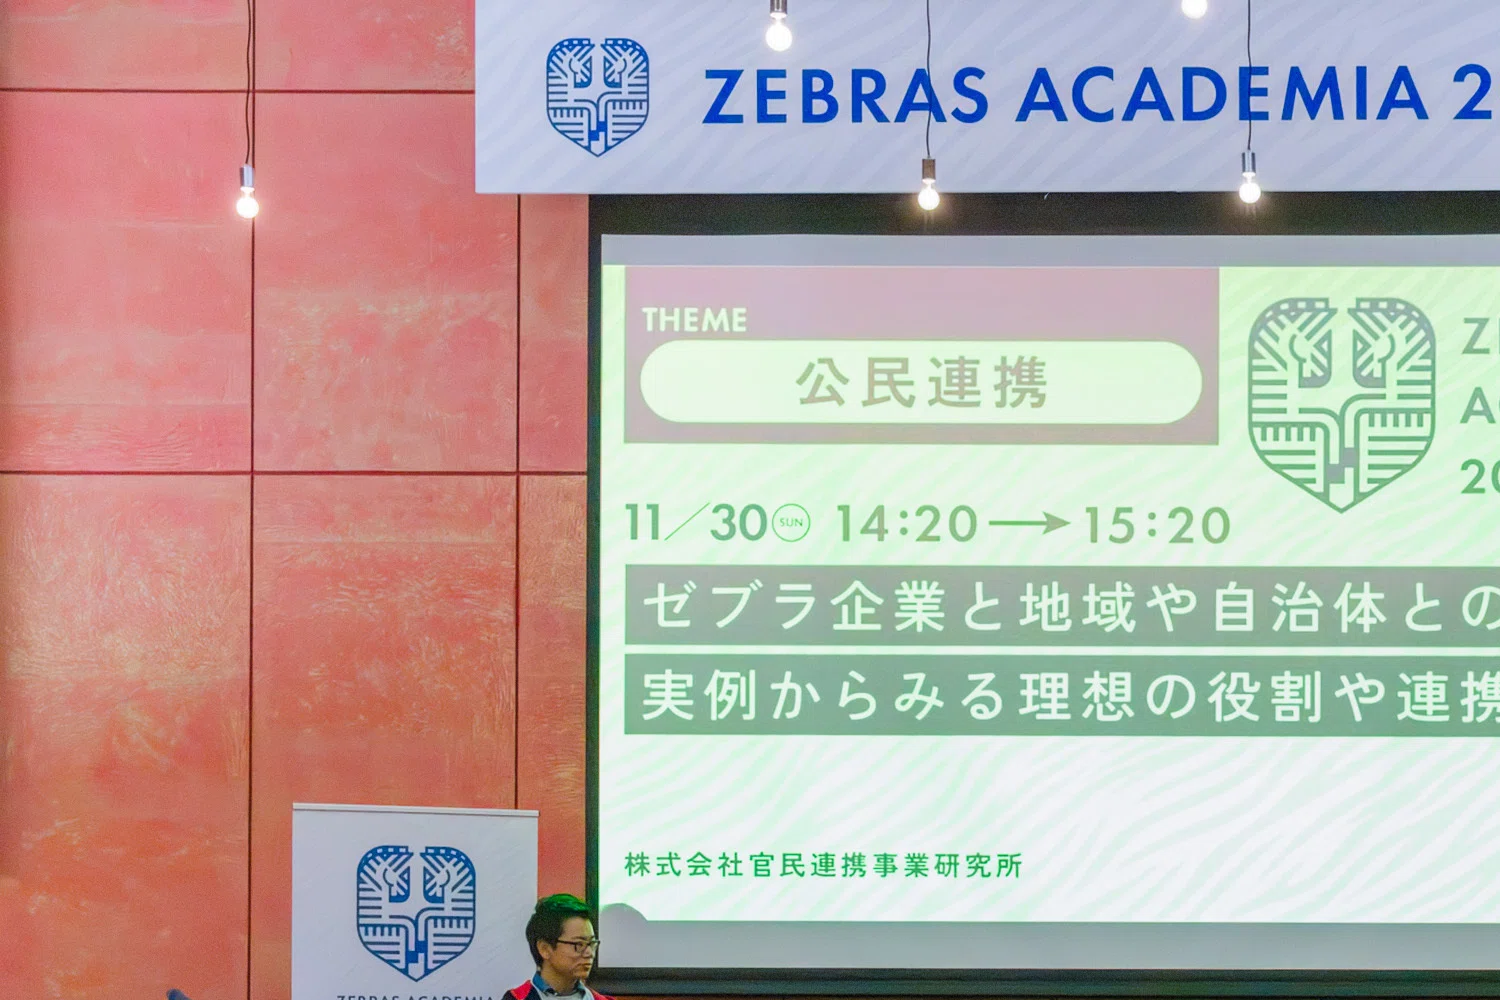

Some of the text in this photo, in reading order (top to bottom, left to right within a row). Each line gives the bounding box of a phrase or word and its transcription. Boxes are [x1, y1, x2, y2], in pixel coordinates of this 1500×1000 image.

[702, 66, 988, 125] ZEBRAS
[1014, 65, 1429, 123] ACADEMIA
[642, 307, 747, 332] THEME
[796, 354, 1048, 409] 公民連携
[779, 517, 804, 528] SUN
[837, 504, 978, 543] 14:20
[1085, 506, 1231, 545] 15:20
[624, 852, 1023, 879] 株式会社官民連携事業研究所
